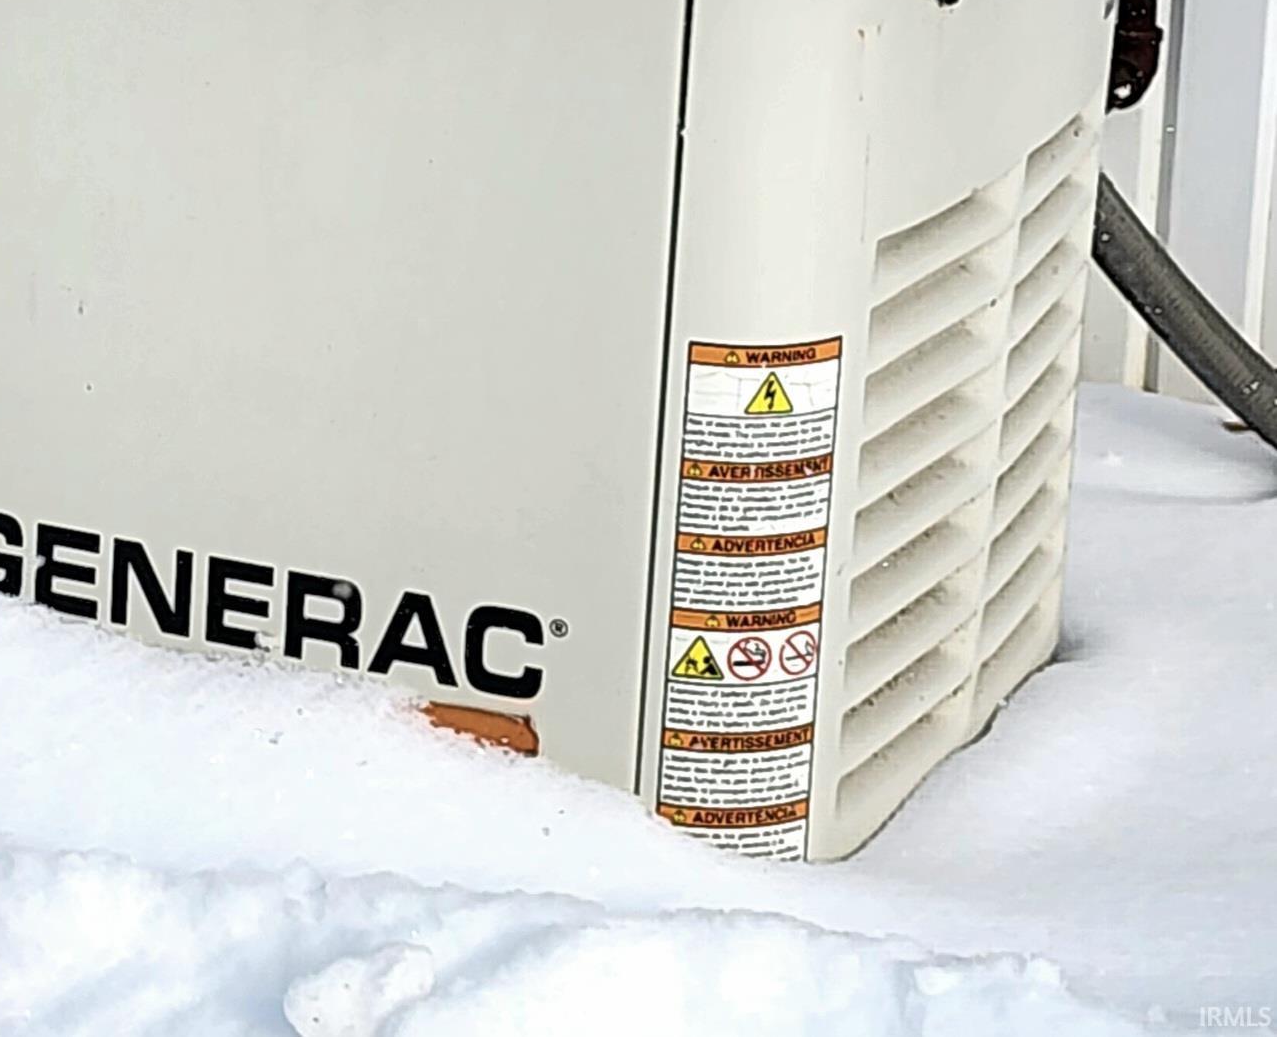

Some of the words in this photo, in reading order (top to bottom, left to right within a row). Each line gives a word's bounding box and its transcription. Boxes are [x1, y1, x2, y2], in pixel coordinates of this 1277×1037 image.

[745, 346, 817, 364] WARNING
[712, 532, 816, 553] ADVERTENCIA
[725, 608, 797, 628] WARNING
[689, 728, 810, 750] AVERTISSEMENT
